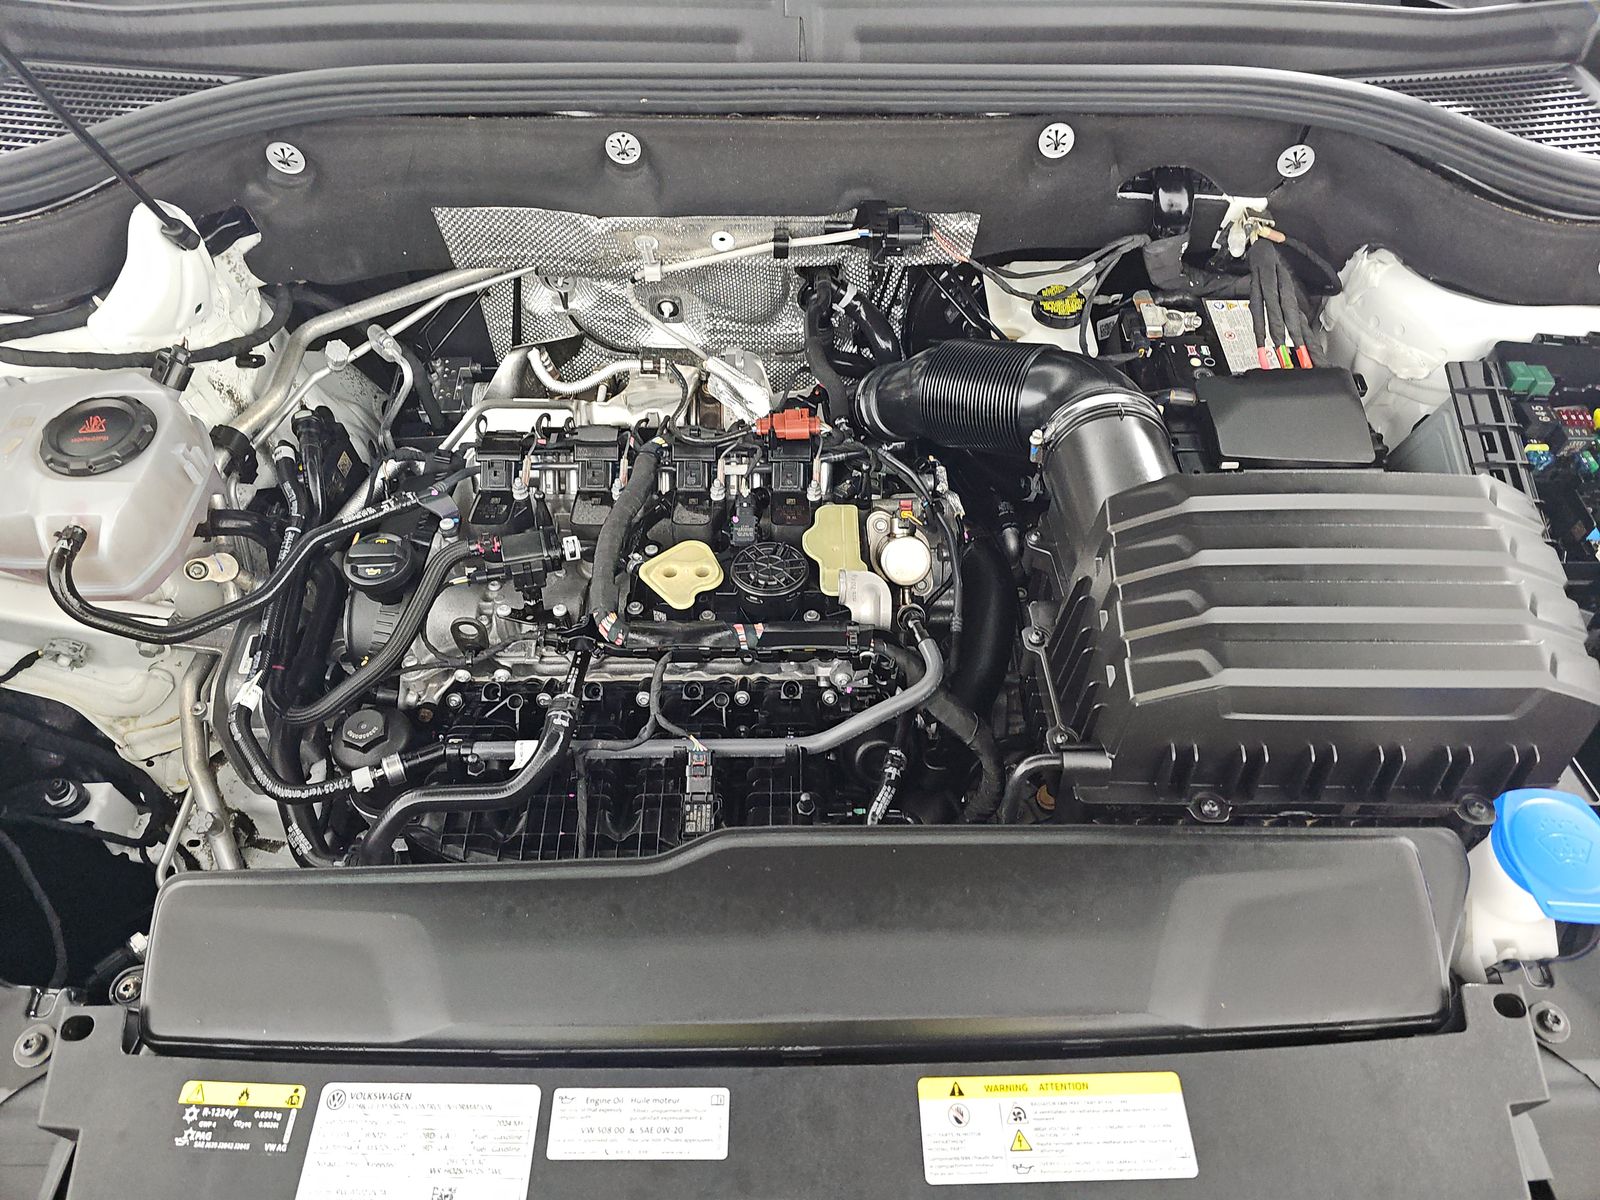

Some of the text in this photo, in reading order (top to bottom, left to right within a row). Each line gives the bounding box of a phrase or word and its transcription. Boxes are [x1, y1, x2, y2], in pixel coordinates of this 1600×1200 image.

[983, 1082, 1089, 1092] WARNING ATTENTION
[350, 1092, 412, 1101] VOLKSWAGEN
[585, 1097, 610, 1107] Engine
[202, 1107, 240, 1120] R-1234yf
[274, 1112, 283, 1122] kg
[613, 1126, 626, 1134] 00
[194, 1131, 213, 1141] PAG
[264, 1143, 277, 1152] VW
[276, 1143, 288, 1152] AG
